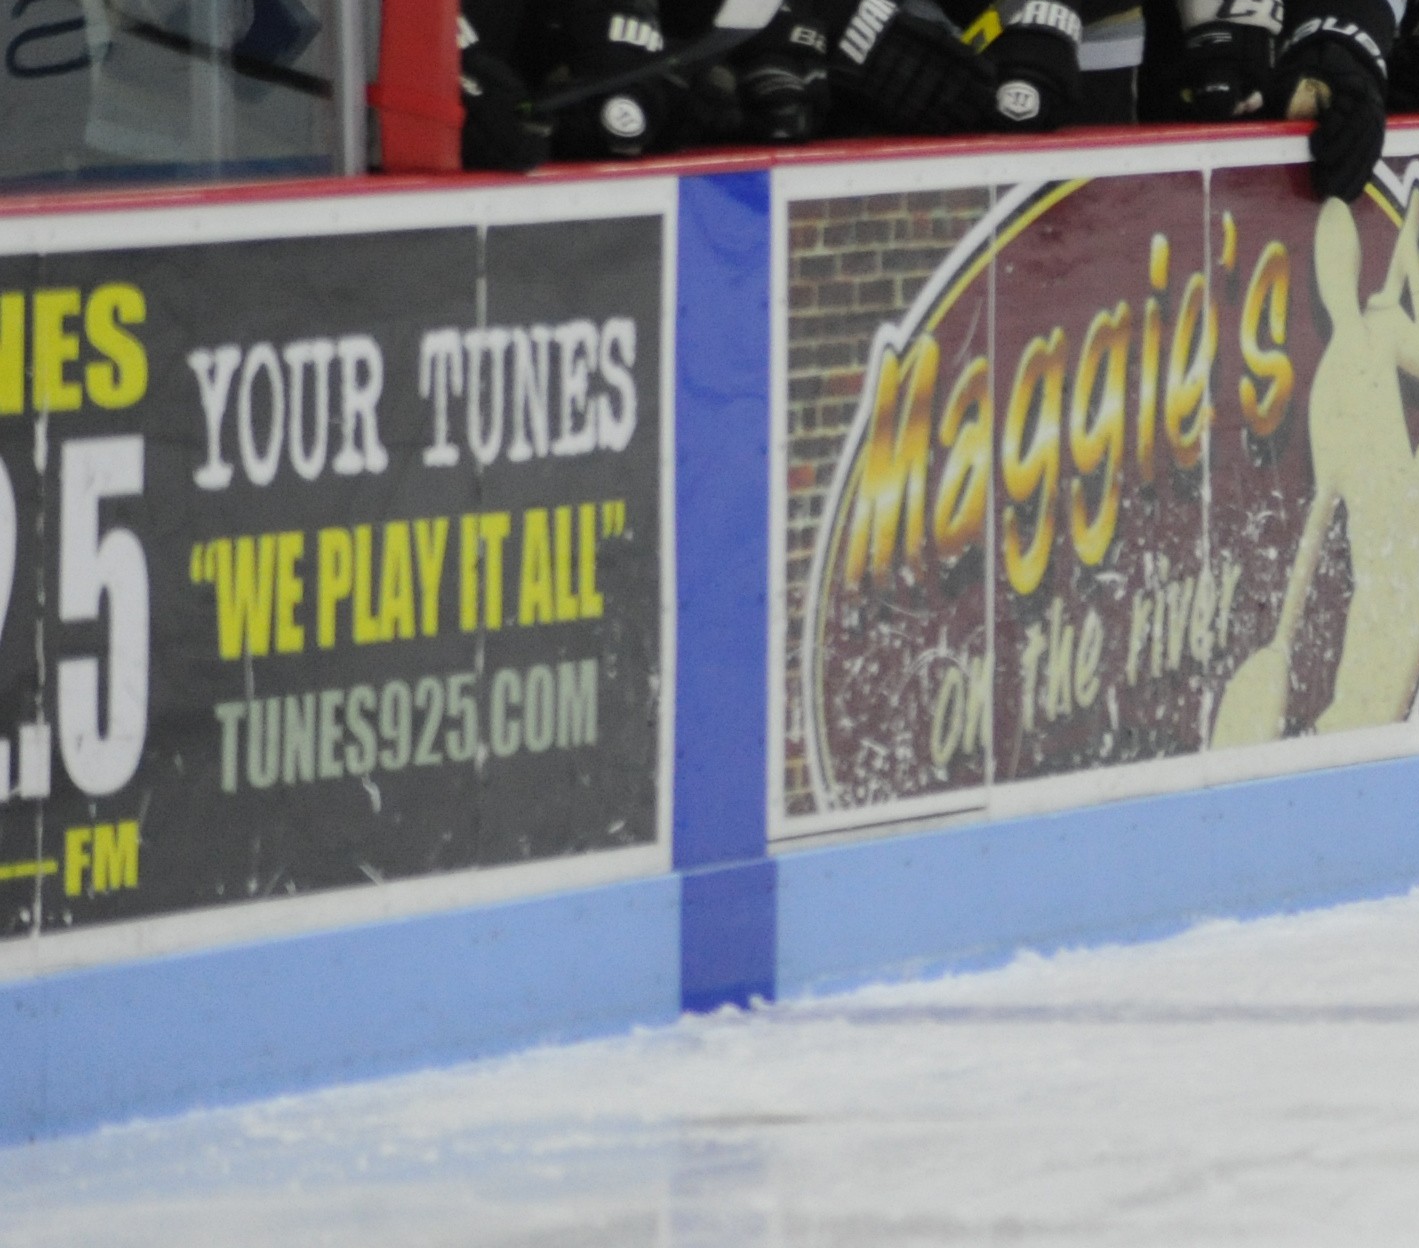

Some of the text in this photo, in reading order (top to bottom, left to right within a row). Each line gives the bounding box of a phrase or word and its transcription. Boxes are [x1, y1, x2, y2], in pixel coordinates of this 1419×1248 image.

[188, 317, 637, 490] YOUR TUNES
[846, 211, 1293, 594] Maggie's
[316, 516, 449, 650] PLAY
[460, 513, 510, 632] IT
[216, 658, 599, 794] TUNES925.COM
[65, 820, 139, 896] FM
